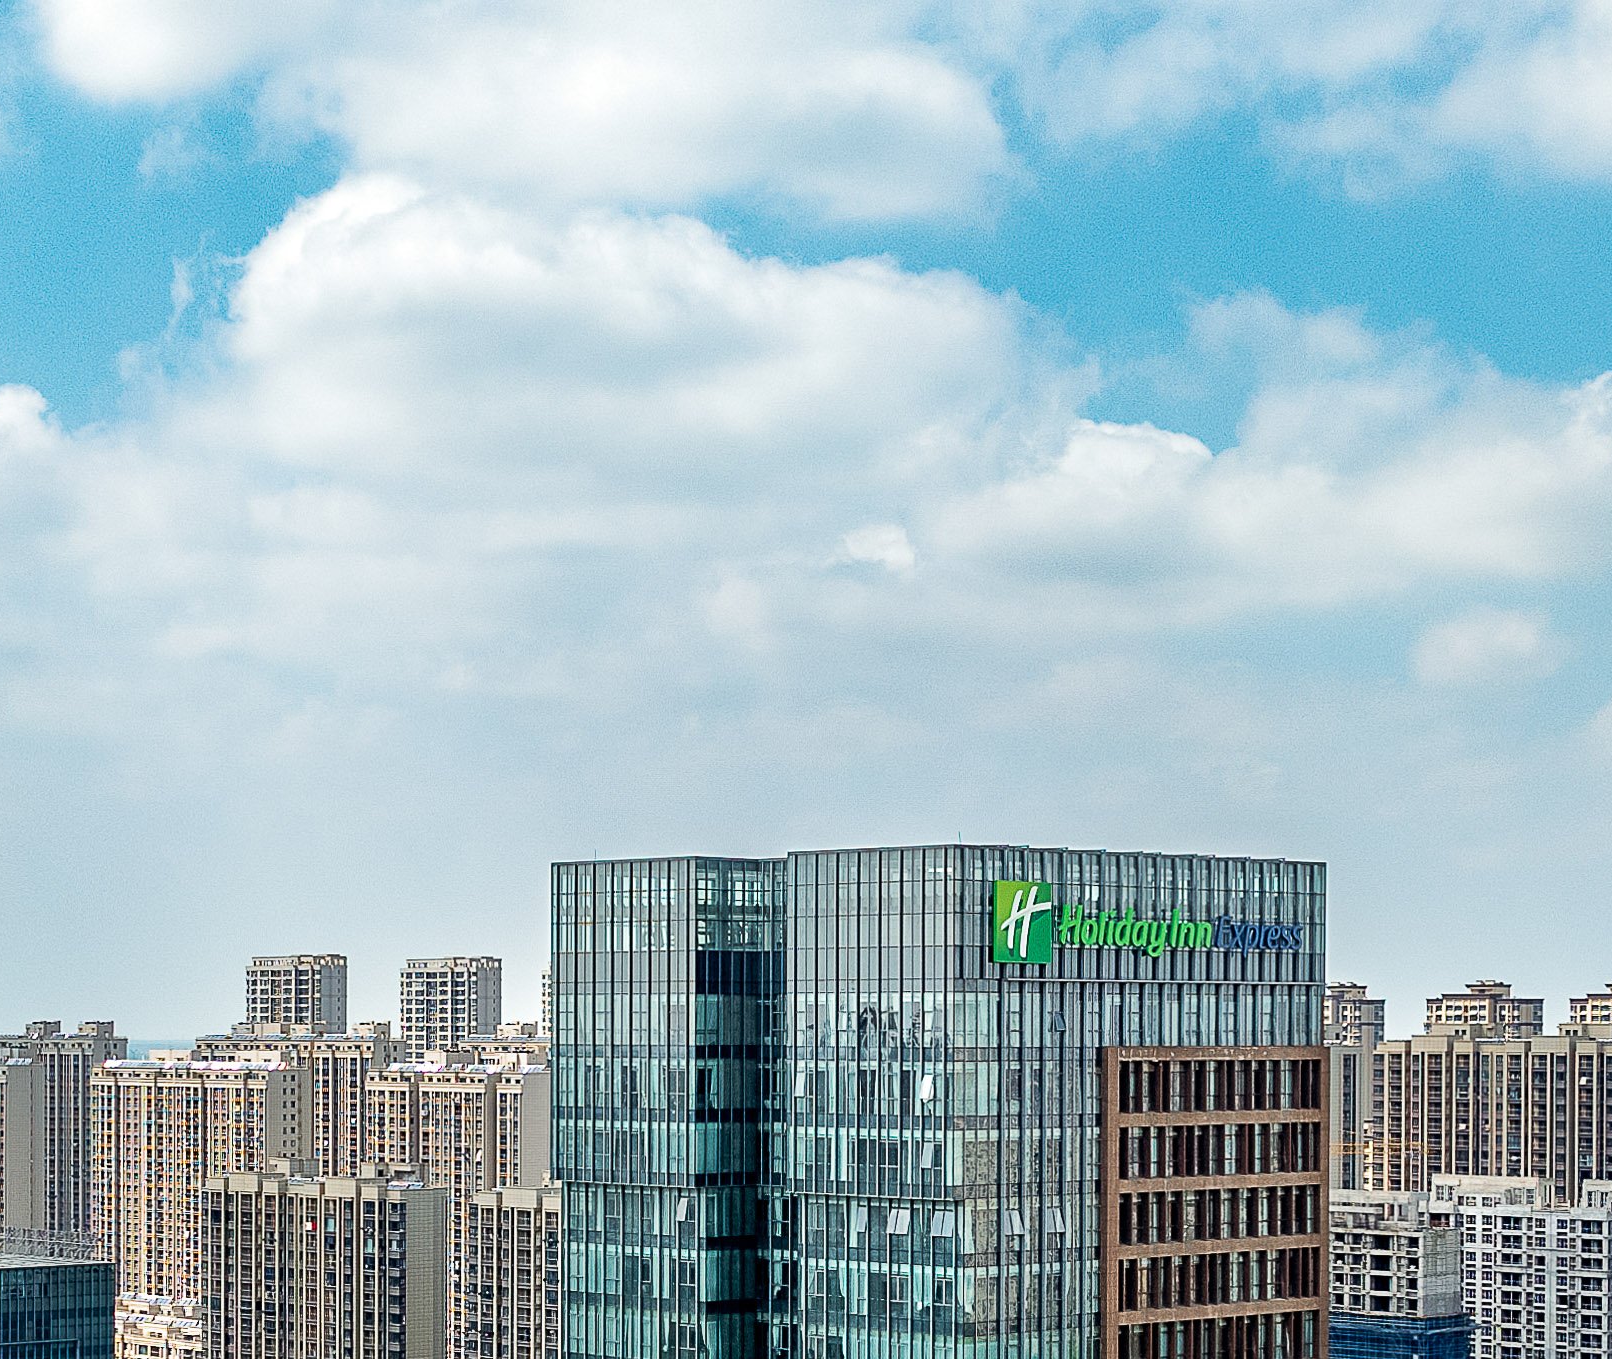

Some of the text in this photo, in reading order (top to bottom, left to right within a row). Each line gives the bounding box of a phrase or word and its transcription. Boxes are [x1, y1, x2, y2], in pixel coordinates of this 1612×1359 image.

[1058, 904, 1303, 958] Holiday Inn Express
